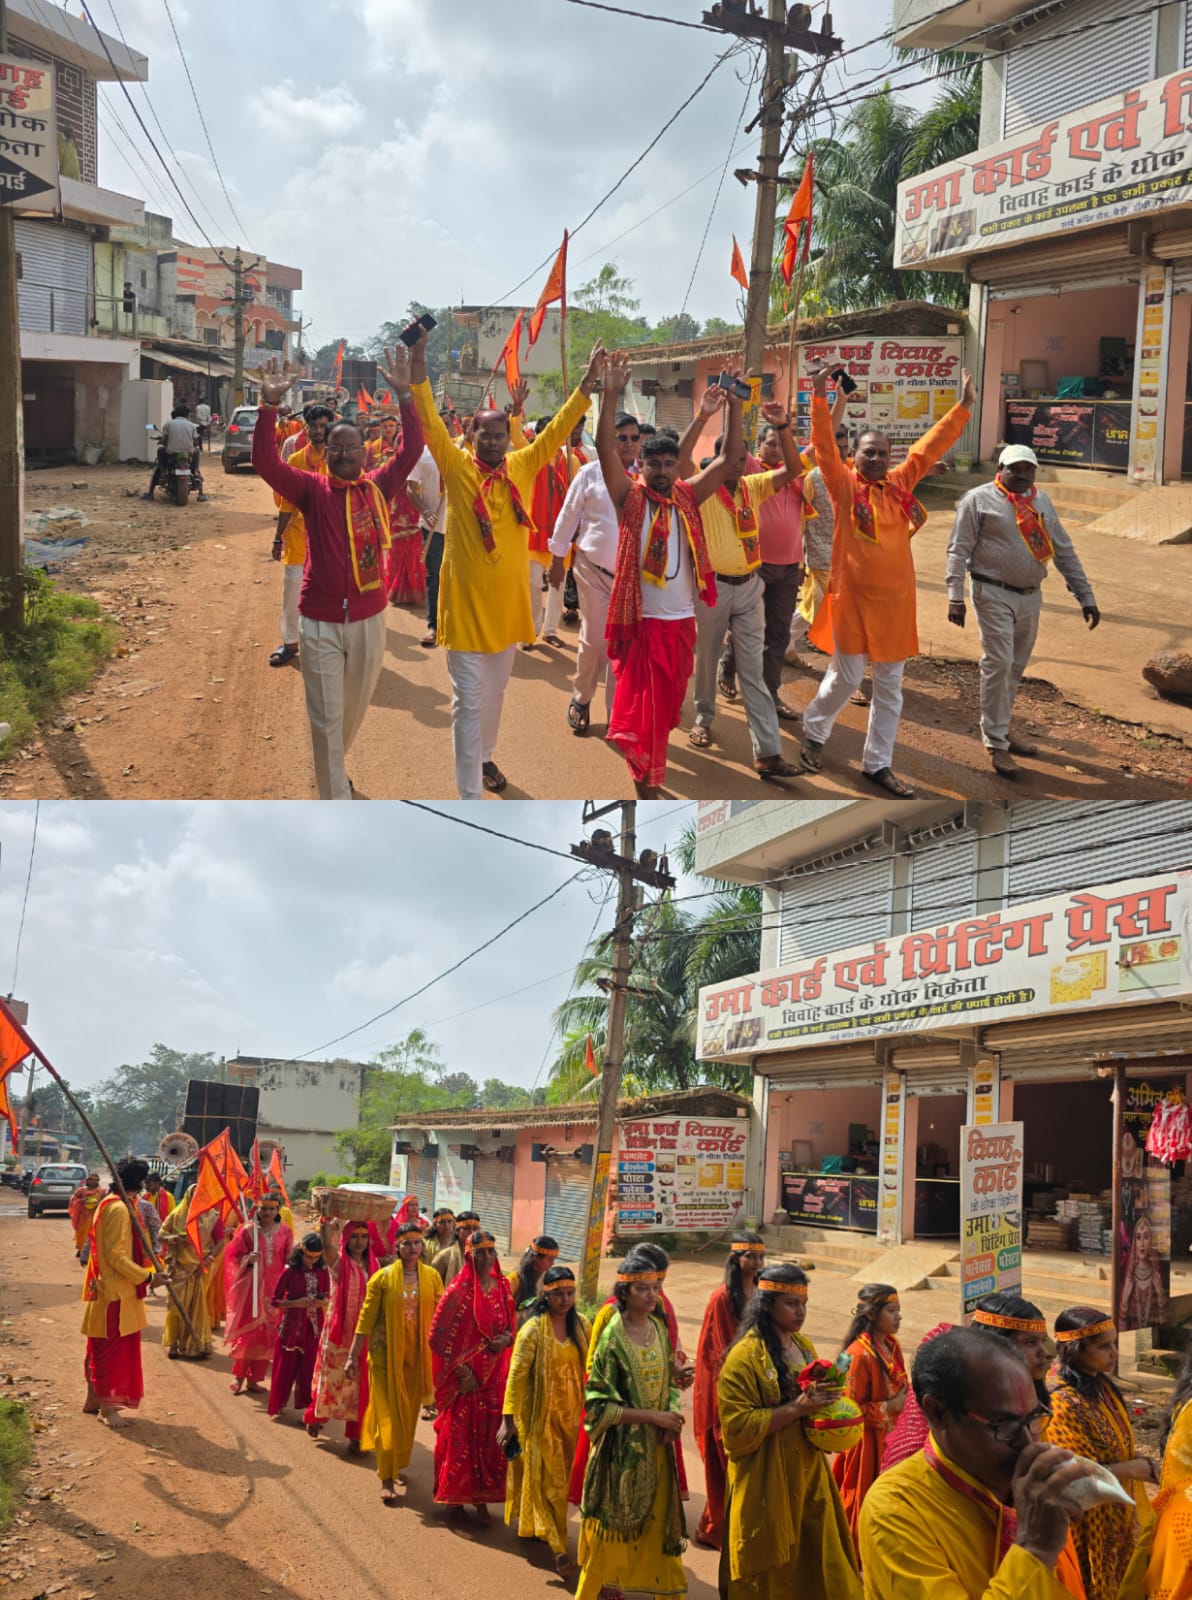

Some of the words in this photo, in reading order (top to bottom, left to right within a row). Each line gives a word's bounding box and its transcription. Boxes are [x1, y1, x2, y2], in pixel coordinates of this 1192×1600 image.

[905, 168, 967, 222] उमा
[972, 121, 1059, 196] कार्ड
[1067, 90, 1147, 161] एवं
[998, 187, 1050, 215] विवाह
[1055, 168, 1096, 197] कार्ड
[1102, 162, 1124, 184] के
[1131, 145, 1187, 176] थोक
[880, 341, 945, 362] विवाह
[894, 356, 960, 378] कार्ड
[705, 984, 755, 1021] उमा
[760, 956, 828, 1008] कार्ड
[834, 943, 890, 992] एवं
[900, 912, 1053, 981] प्रिंटिंग
[1064, 884, 1178, 951] प्रेस
[782, 1006, 821, 1024] विवाह
[825, 996, 856, 1017] कार्ड
[859, 994, 874, 1011] के
[880, 987, 919, 1006] थोक
[924, 975, 989, 1000] विक्रेता
[685, 1121, 735, 1139] विवाह
[696, 1134, 746, 1152] कार्ड
[967, 1129, 1015, 1162] विवाह
[973, 1149, 1022, 1195] कार्ड
[966, 1215, 990, 1237] उमा
